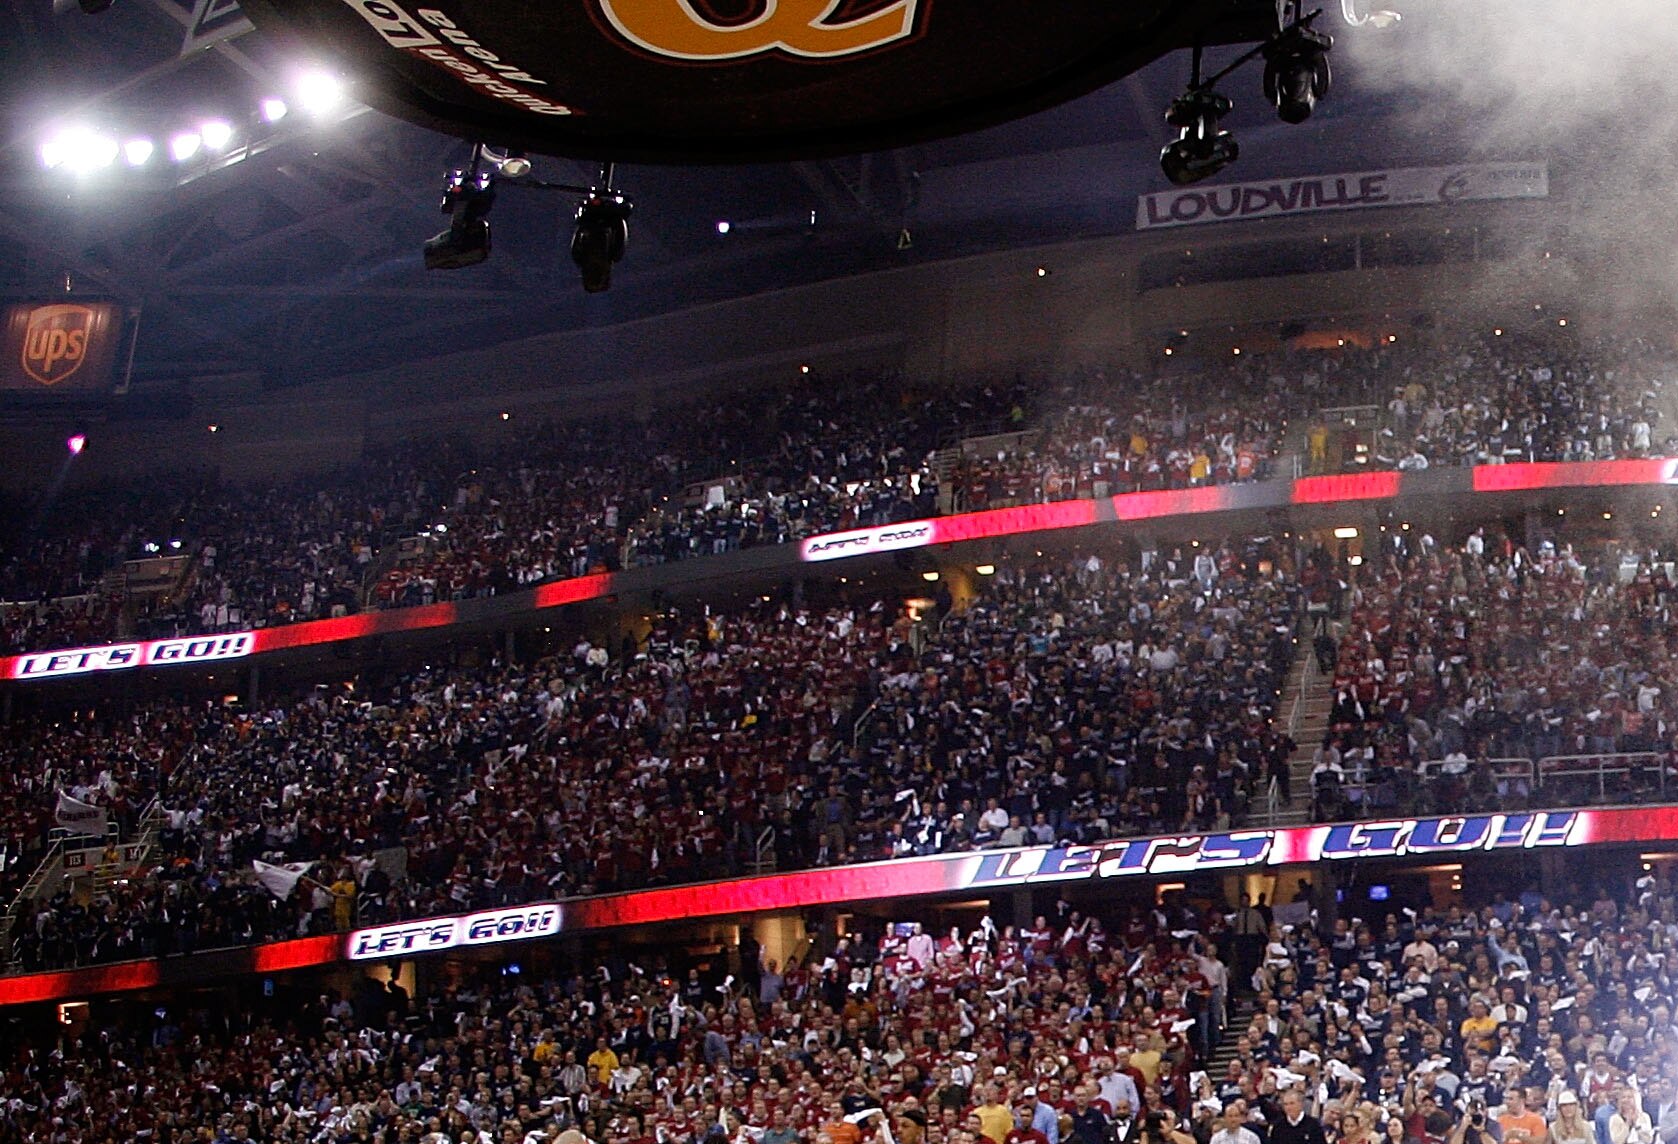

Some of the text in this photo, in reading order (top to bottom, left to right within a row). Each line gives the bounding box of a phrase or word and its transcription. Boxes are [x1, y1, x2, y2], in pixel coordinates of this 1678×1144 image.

[417, 7, 548, 86] Arena
[418, 46, 572, 116] Quicken
[1146, 174, 1390, 226] LOUDVILLE
[27, 329, 84, 373] ups
[21, 636, 249, 676] LET'S GO!!
[960, 828, 1278, 887] LET'S
[353, 923, 455, 956] LET'S
